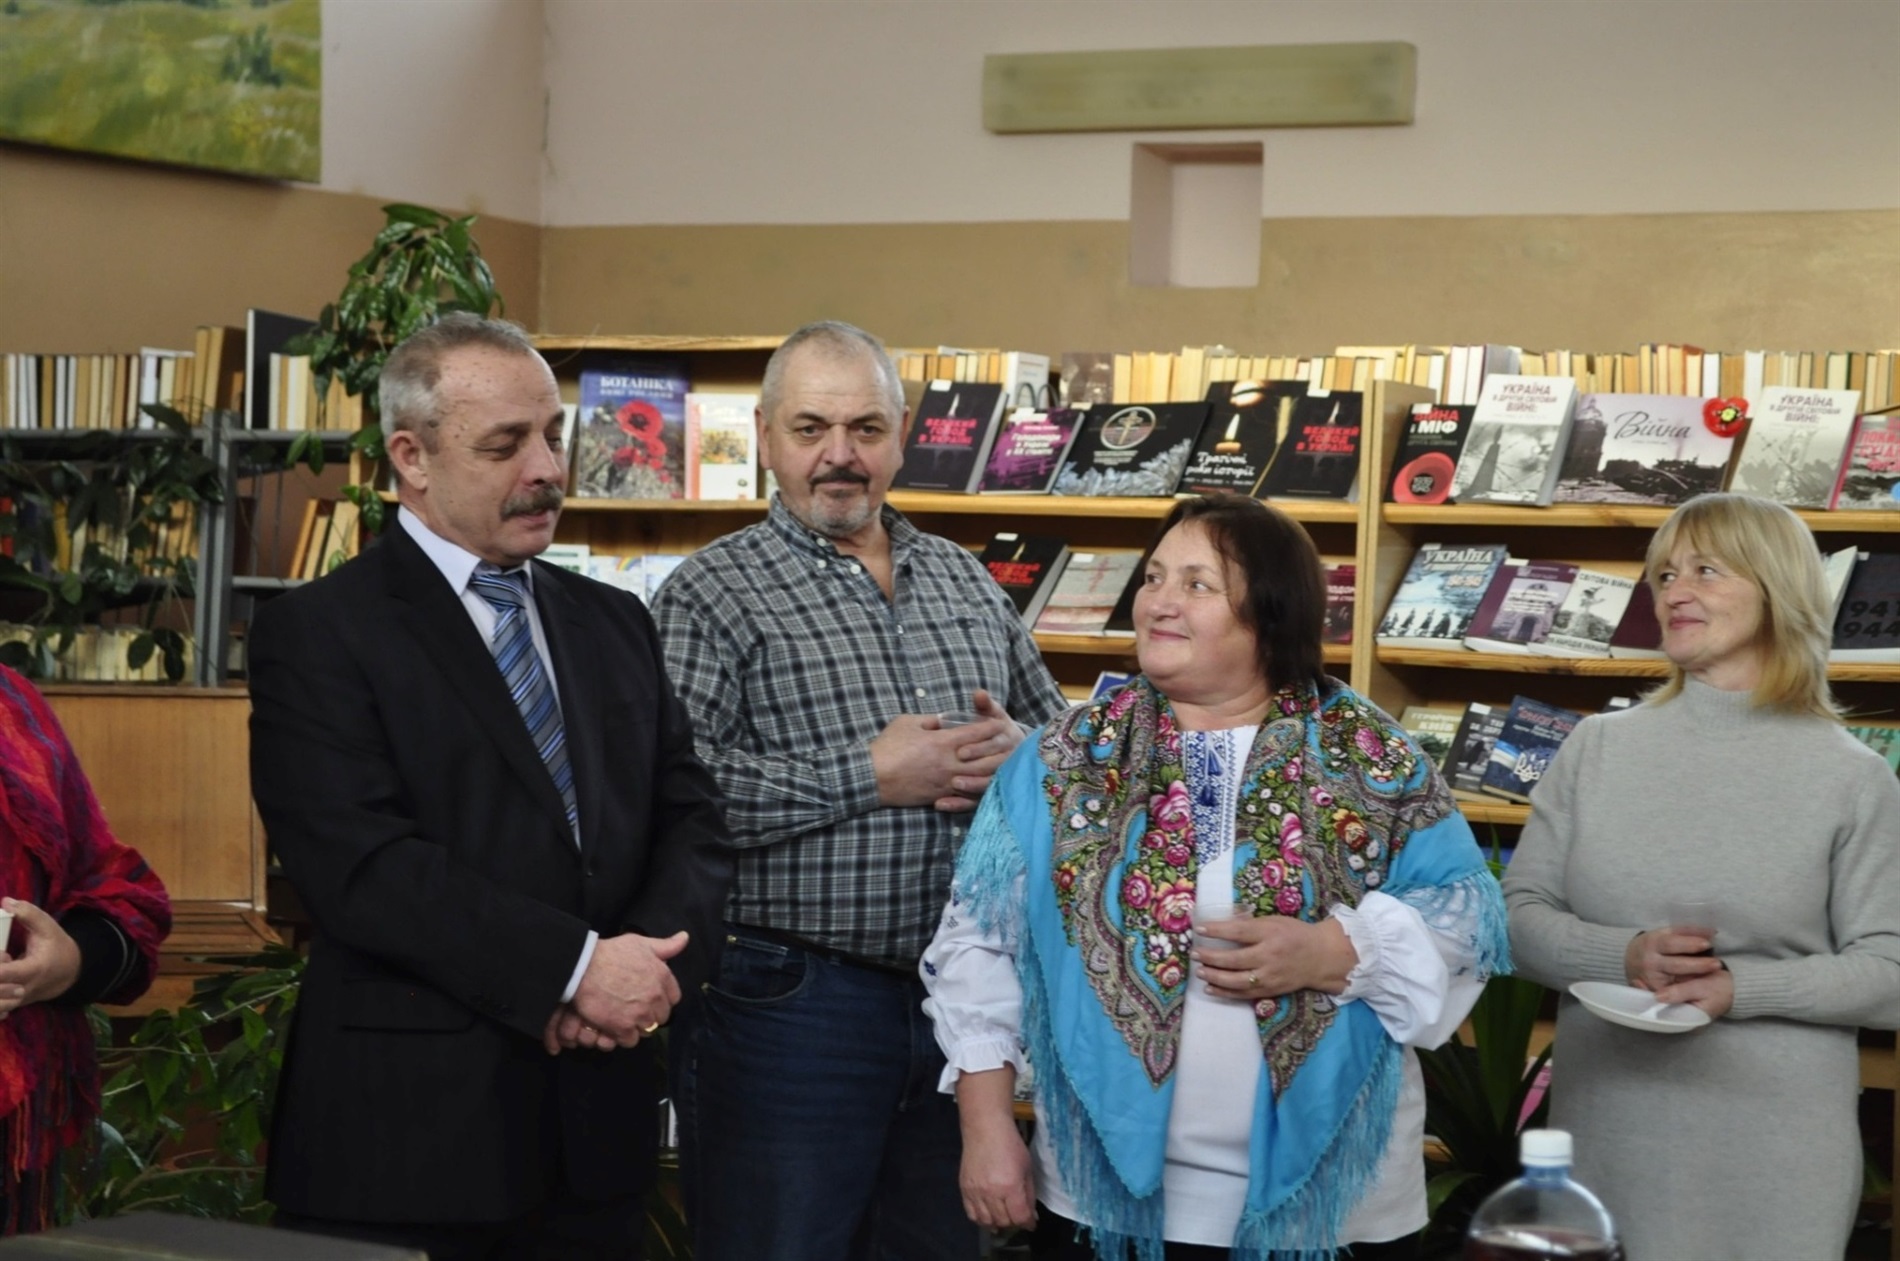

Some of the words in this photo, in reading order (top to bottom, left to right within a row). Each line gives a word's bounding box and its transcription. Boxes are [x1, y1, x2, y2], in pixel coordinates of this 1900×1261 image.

[600, 376, 673, 391] БОТАНІКА
[1503, 382, 1551, 395] УКРАЇНА
[1781, 394, 1833, 407] УКРАЇНА
[1417, 420, 1458, 433] МІФ
[1614, 411, 1692, 439] Війна
[1422, 548, 1493, 565] УКРАЇНА
